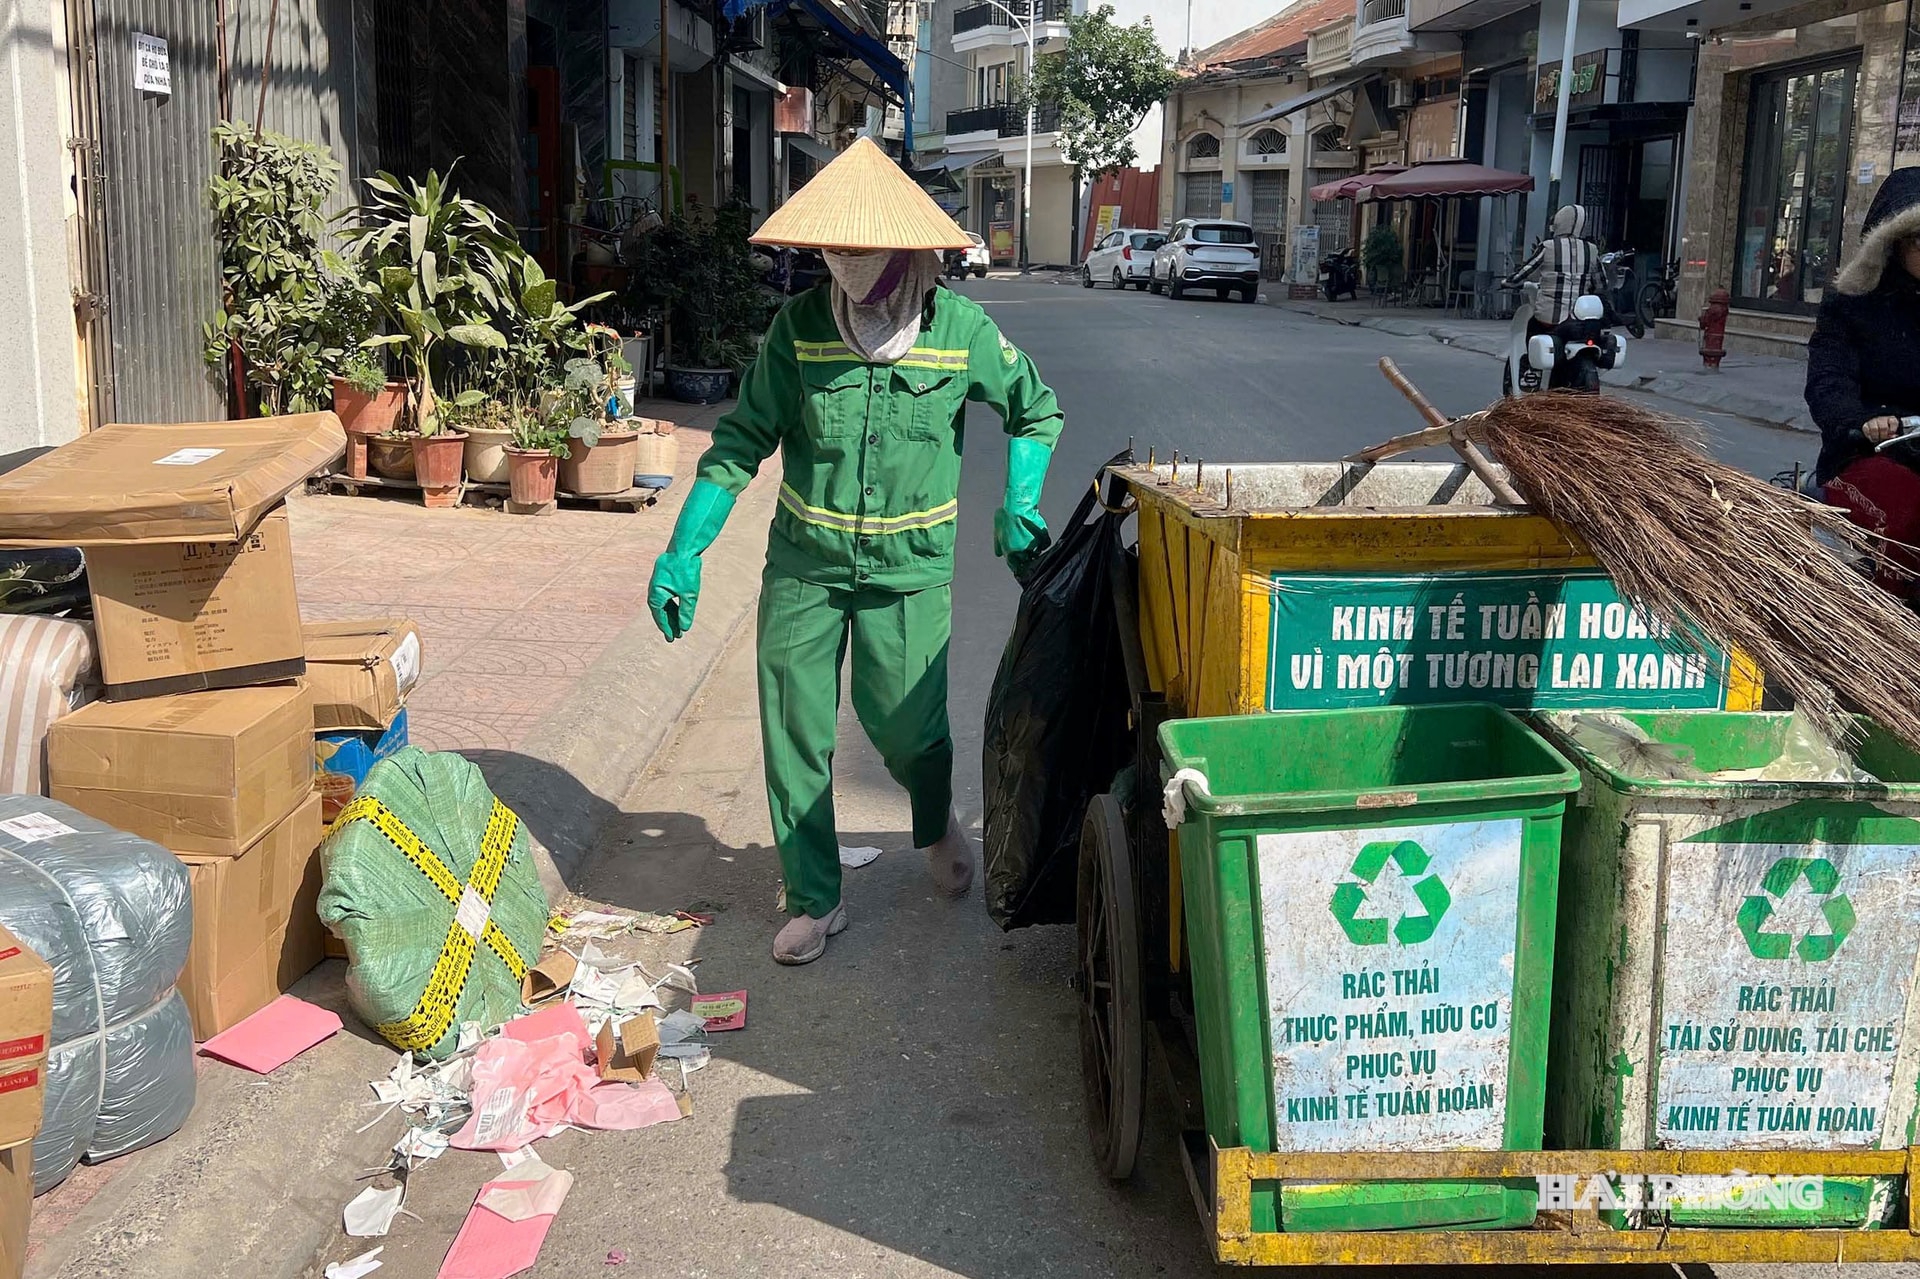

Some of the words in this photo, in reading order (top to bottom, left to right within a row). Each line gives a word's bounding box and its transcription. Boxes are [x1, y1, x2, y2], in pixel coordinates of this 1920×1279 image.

[1332, 606, 1415, 640] KINH
[1428, 592, 1466, 640] TẾ
[1479, 591, 1567, 640] TUẦN
[1291, 647, 1324, 689] VÌ
[1336, 646, 1414, 696] MỘT
[1426, 651, 1539, 689] TƯƠNG
[1551, 653, 1604, 688] LAI
[1615, 653, 1706, 689] XANH
[387, 817, 414, 845] FRAGILE
[485, 823, 498, 851] FRAGILE
[484, 857, 497, 885] FRAGILE
[449, 953, 464, 985] FRAGILE
[1343, 966, 1385, 999] RÁC
[1392, 959, 1439, 996] THẢI
[1737, 980, 1782, 1012] RÁC
[1790, 978, 1836, 1012] THẢI
[415, 1012, 444, 1041] FRAGILE
[1283, 1013, 1338, 1047] THỰC
[1345, 1002, 1414, 1040] PHẨM,
[1421, 1003, 1463, 1035] HỮU
[1471, 1001, 1498, 1031] CƠ
[1668, 1020, 1701, 1051] TÁI
[1707, 1017, 1740, 1051] SỬ
[1816, 1021, 1848, 1053] TÁI
[1853, 1018, 1898, 1053] CHẾ
[1346, 1051, 1403, 1083] PHỤC
[1410, 1049, 1437, 1080] VỤ
[1732, 1067, 1789, 1098] PHỤC
[1796, 1067, 1823, 1098] VỤ
[1287, 1096, 1338, 1122] KINH
[1345, 1085, 1370, 1119] TẾ
[1376, 1081, 1430, 1117] TUẦN
[1438, 1080, 1494, 1113] HOÀN
[1668, 1105, 1720, 1131] KINH
[1727, 1099, 1753, 1131] TẾ
[1757, 1098, 1813, 1131] TUẦN
[1816, 1101, 1876, 1131] HOÀN
